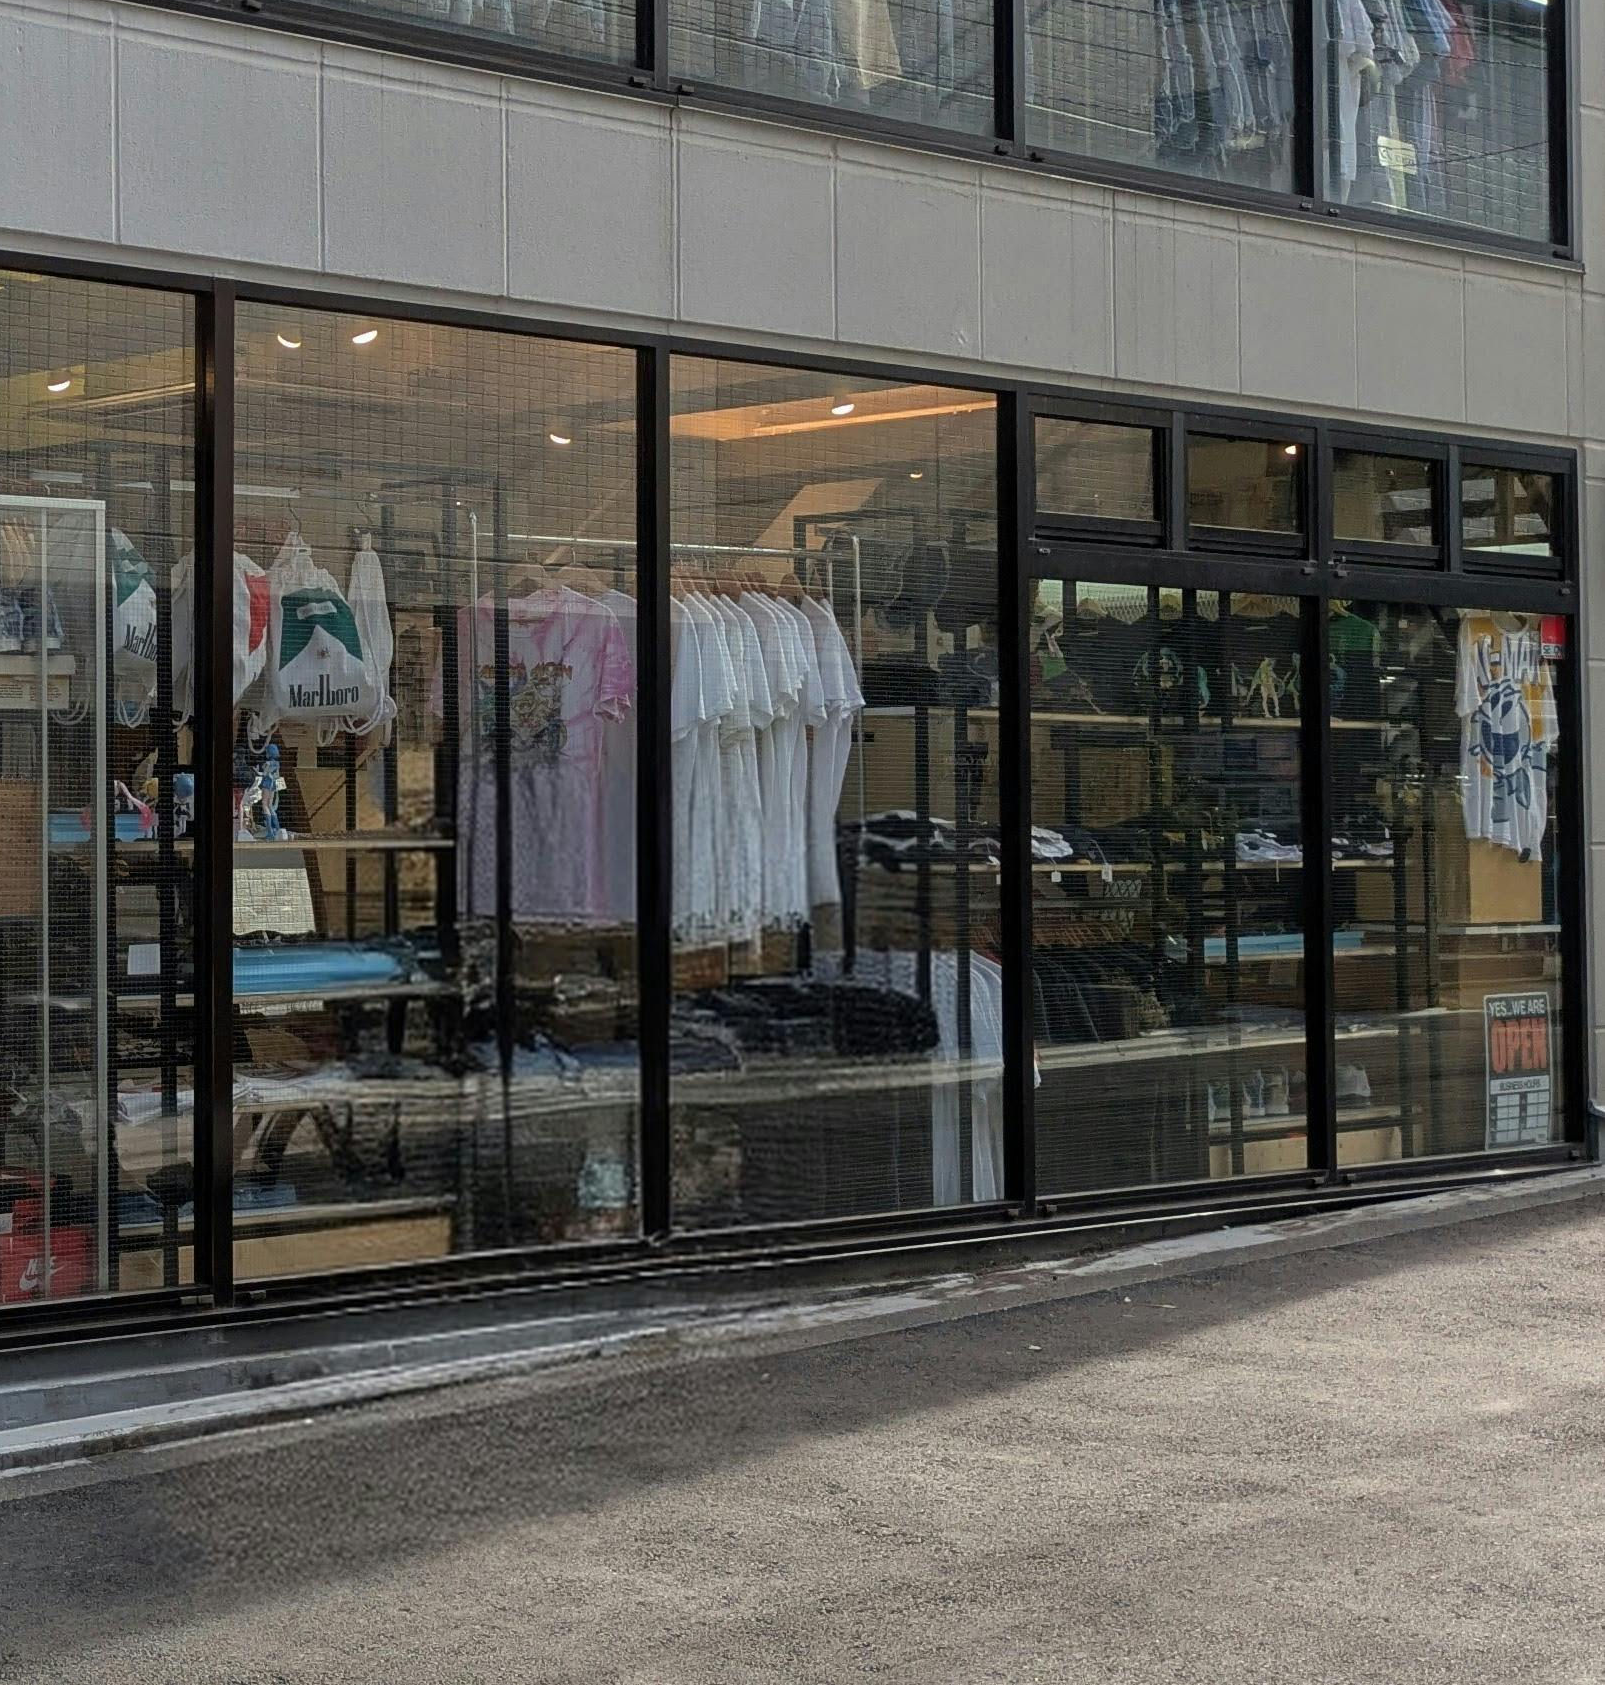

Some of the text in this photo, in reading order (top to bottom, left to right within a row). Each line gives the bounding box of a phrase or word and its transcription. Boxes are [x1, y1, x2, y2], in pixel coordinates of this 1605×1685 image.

[288, 674, 360, 709] Marlboro
[1512, 999, 1526, 1015] WE
[1527, 998, 1545, 1014] ARE
[1490, 1017, 1547, 1075] OPEN
